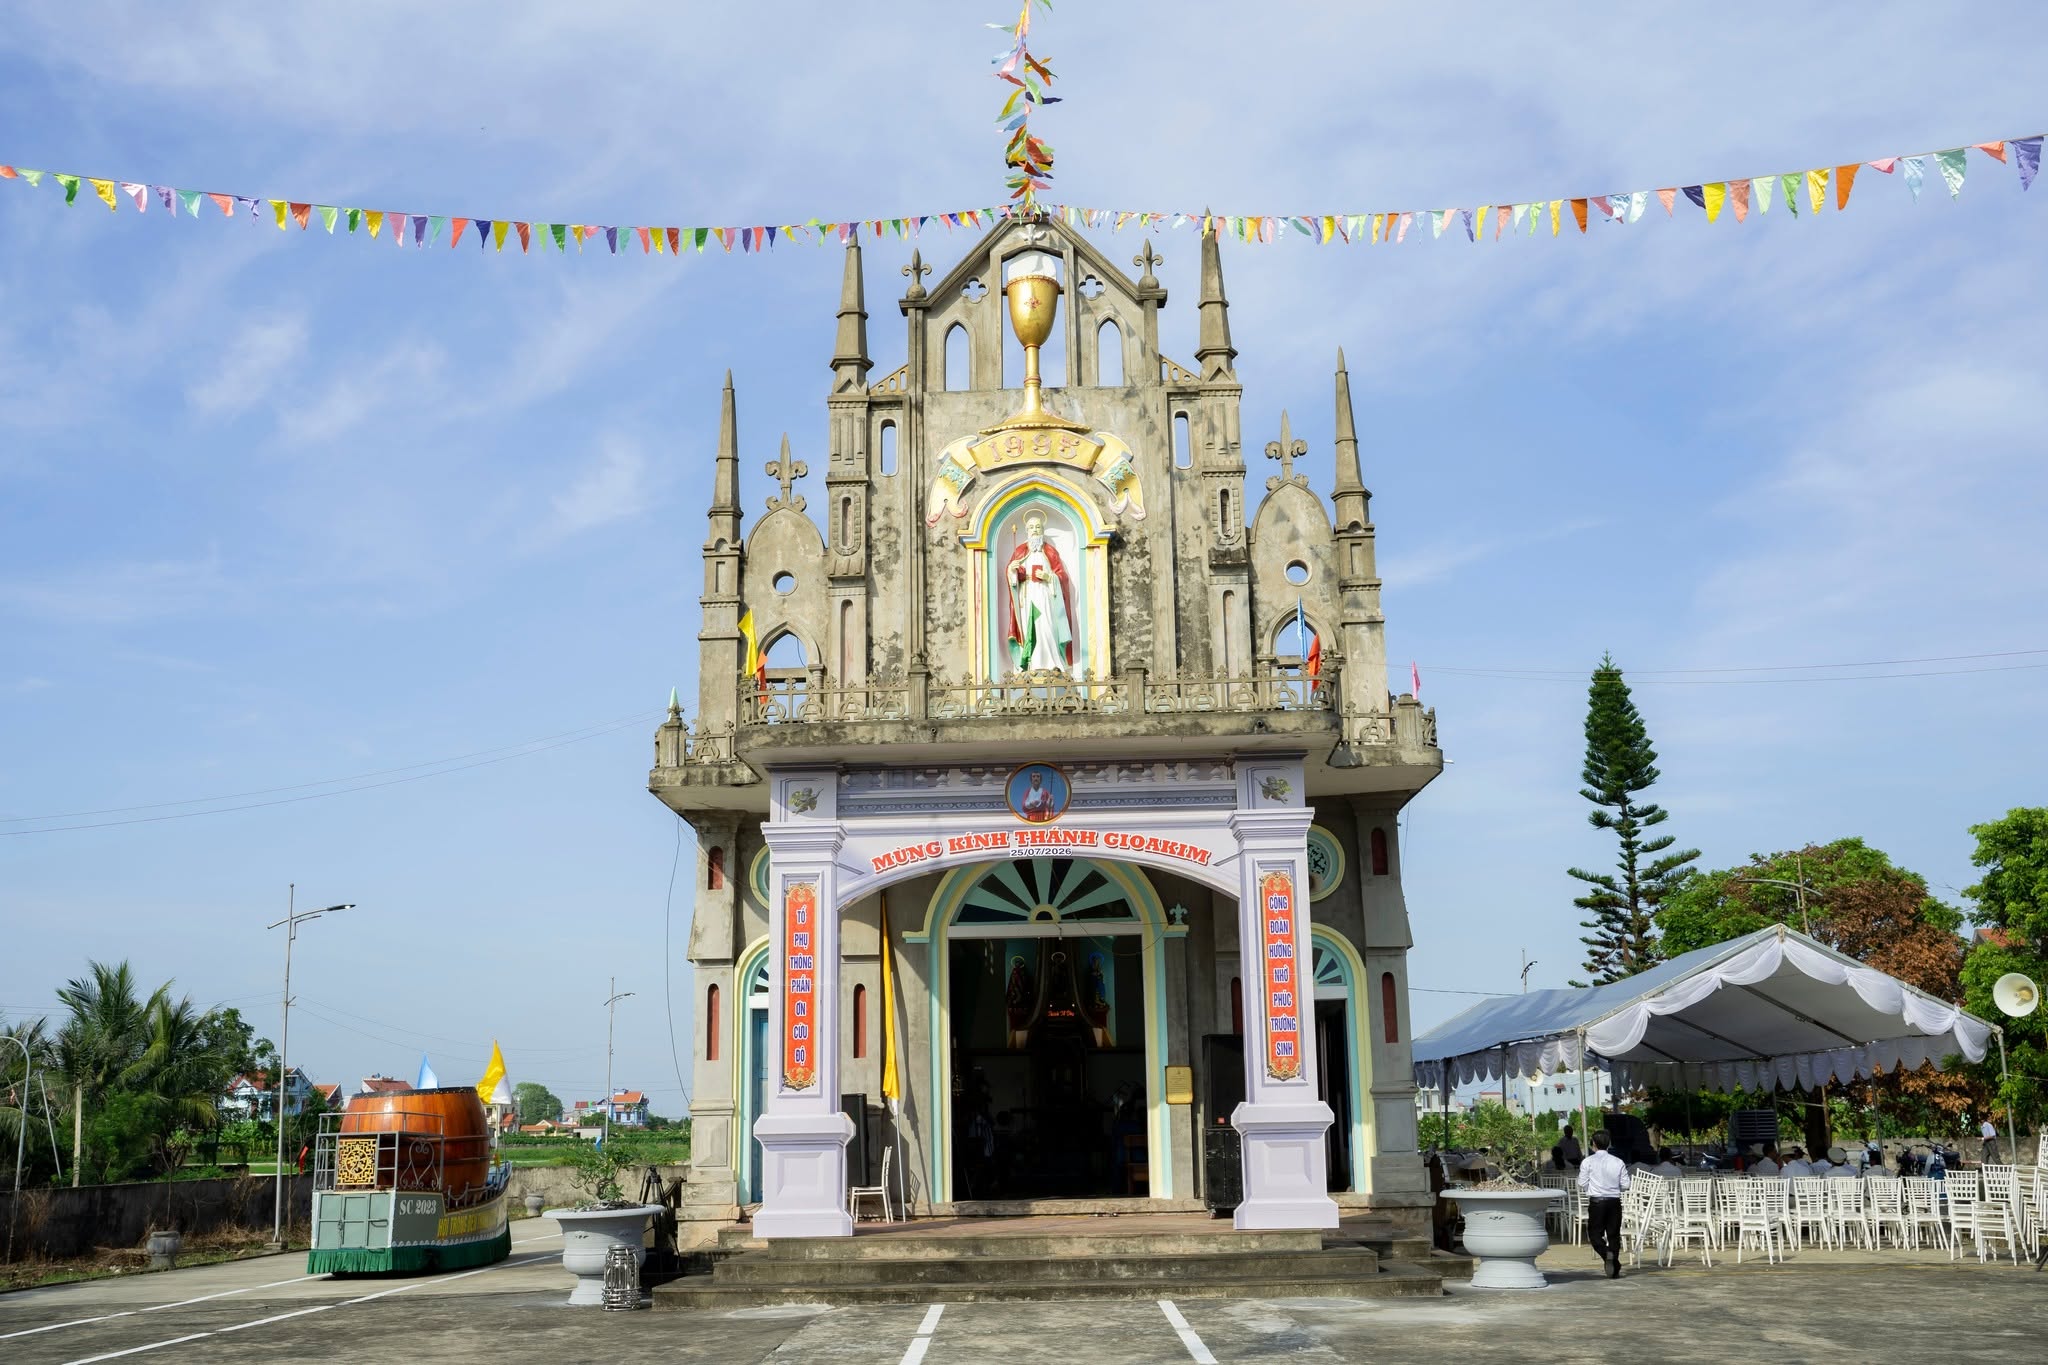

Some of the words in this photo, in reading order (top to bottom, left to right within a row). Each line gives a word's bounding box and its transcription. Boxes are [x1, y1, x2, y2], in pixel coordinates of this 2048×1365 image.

[872, 839, 943, 874] MỪNG
[948, 832, 1010, 855] KÍNH
[1014, 827, 1098, 848] THÁNH
[1103, 832, 1212, 867] GIOAKIM
[1010, 848, 1072, 857] 25/07/2026
[1269, 893, 1288, 912] CỘNG
[1270, 918, 1288, 933] ĐOÀN
[794, 934, 808, 949] PHỤ
[790, 954, 812, 969] THÔNG
[1273, 964, 1289, 982] NHỜ
[1273, 991, 1292, 1007] PHÚC
[1271, 1014, 1297, 1031] TRƯỜNG
[795, 1046, 805, 1065] ĐỘ
[1276, 1042, 1293, 1056] SINH
[400, 1200, 414, 1215] SC
[416, 1200, 437, 1215] 2023
